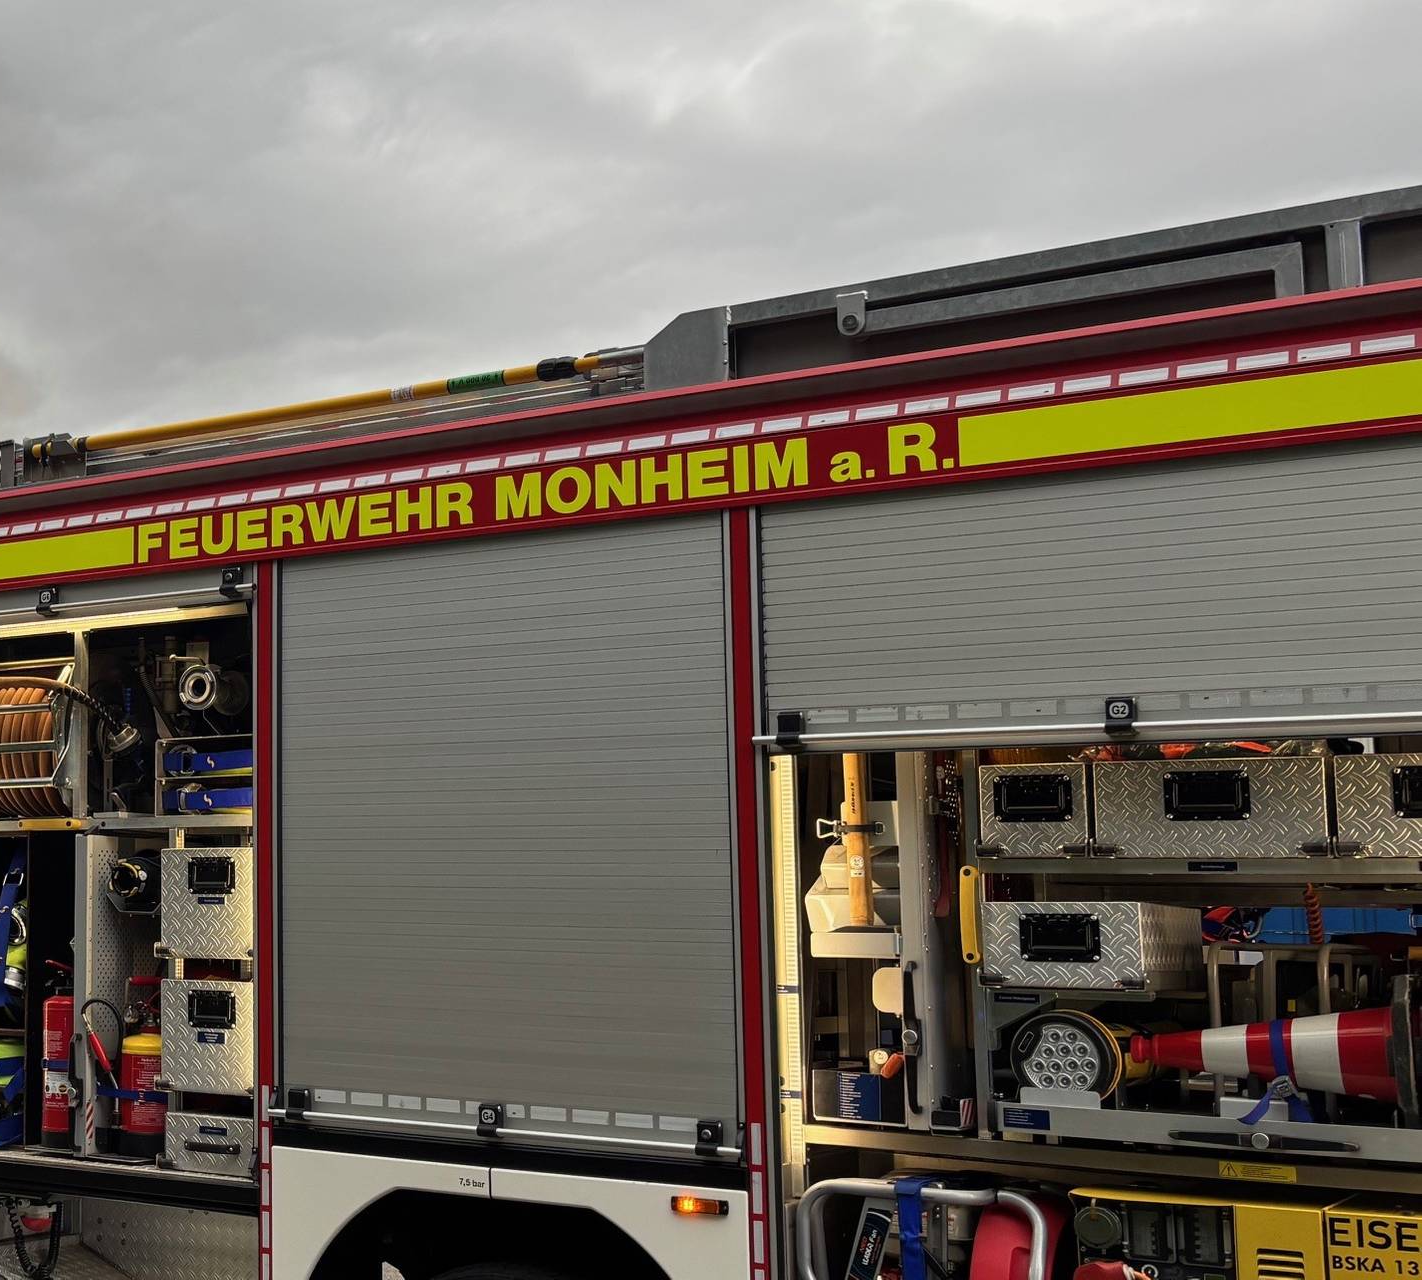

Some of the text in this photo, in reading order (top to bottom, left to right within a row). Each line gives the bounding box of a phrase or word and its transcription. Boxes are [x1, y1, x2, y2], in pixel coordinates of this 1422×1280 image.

[138, 422, 955, 564] FEUERWEHR MONHEIM a. R.
[1112, 705, 1127, 715] G2
[482, 1111, 494, 1121] G4
[459, 1177, 485, 1188] 7,5 bar
[1332, 1255, 1420, 1276] BSKA 13
